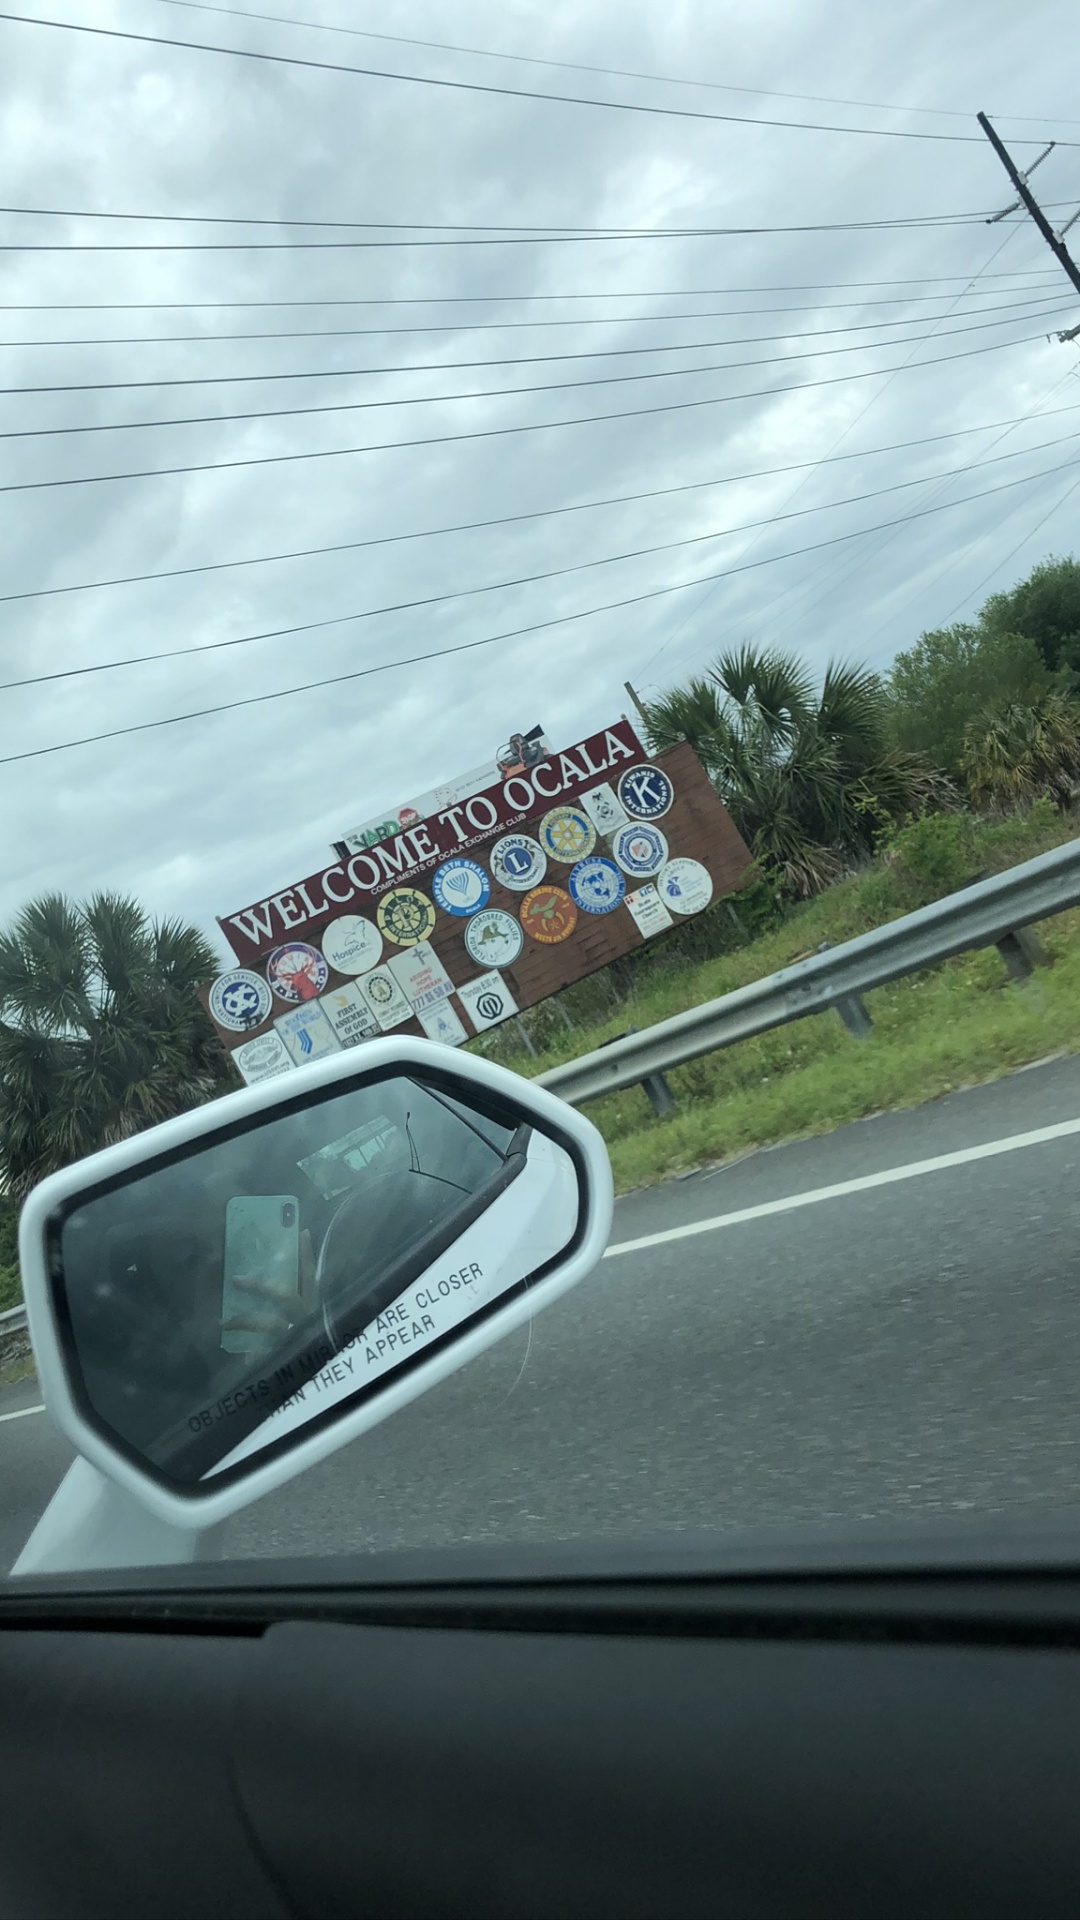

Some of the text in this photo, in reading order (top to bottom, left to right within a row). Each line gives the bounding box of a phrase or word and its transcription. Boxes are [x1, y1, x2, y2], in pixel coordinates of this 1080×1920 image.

[624, 770, 656, 789] KIWANIS
[625, 780, 668, 814] INTERNATIONAL
[631, 776, 661, 808] K
[400, 812, 416, 824] STOP
[229, 730, 635, 945] WELCOME TO OCALA
[352, 820, 399, 848] YARD
[370, 812, 527, 896] COMPLIMENTS OF OCALA EXCHANGE CLUB
[497, 839, 523, 854] LIONS
[507, 852, 529, 873] L
[570, 857, 601, 881] ALTRUSA
[434, 860, 490, 912] TEMPLE BETH SHALOM
[385, 896, 424, 921] PILOT
[521, 895, 533, 918] OCALA
[552, 889, 568, 901] CLUB
[642, 908, 658, 919] Church
[389, 911, 428, 938] INTERNATIONAL
[469, 937, 487, 961] FLORIDA
[504, 918, 519, 941] FILLIES
[332, 941, 367, 962] Hospice
[221, 975, 233, 989] FOR
[233, 973, 259, 985] SERVICE
[409, 967, 433, 983] ABIDING
[416, 975, 432, 986] HOPE
[412, 977, 442, 997] LUTHERAN
[460, 985, 483, 999] Thursday
[337, 1003, 358, 1018] FIRST
[411, 995, 425, 1010] 777
[334, 1007, 369, 1030] ASSEMBLY
[352, 1018, 368, 1031] GOD
[188, 1379, 270, 1432] OBJECTS
[276, 1366, 295, 1386] IN
[375, 1303, 410, 1334] ARE
[415, 1262, 484, 1310] CLOSER
[310, 1357, 355, 1395] THEY
[365, 1314, 436, 1365] APPEAR
